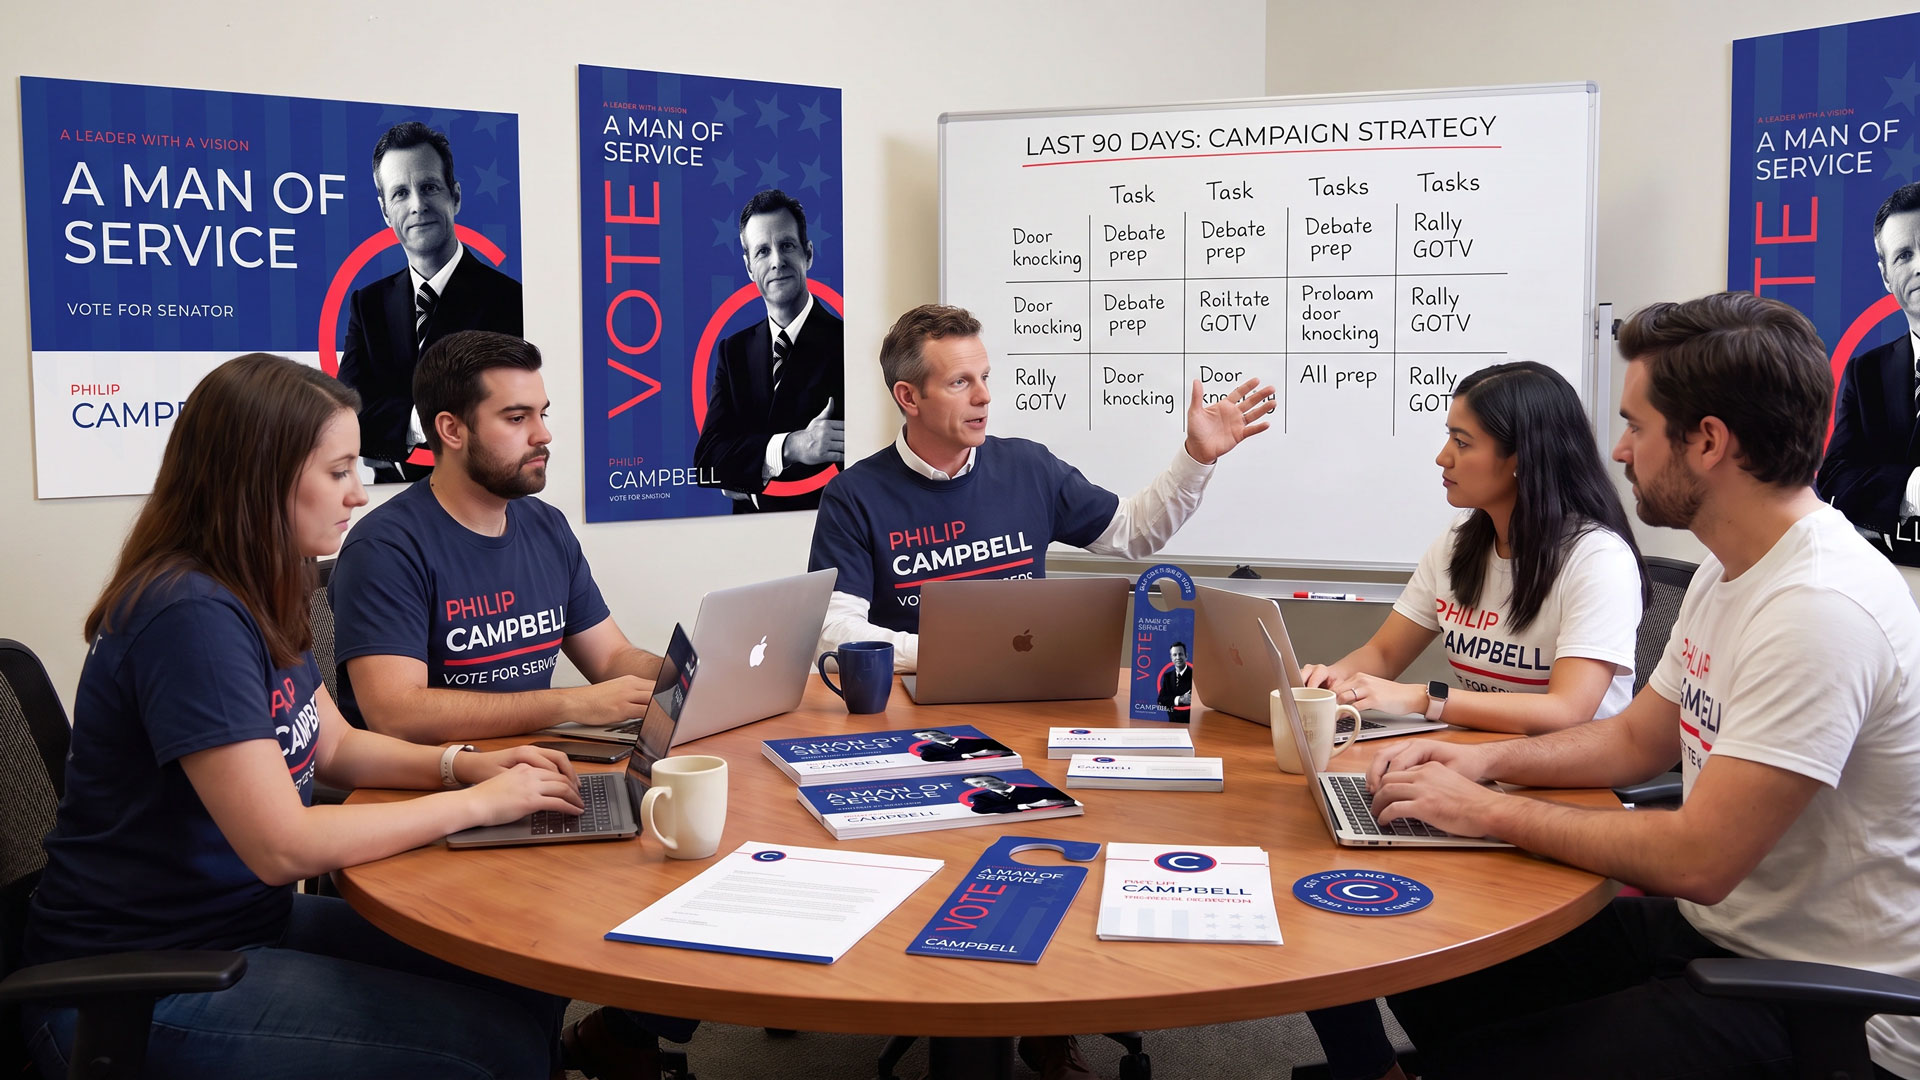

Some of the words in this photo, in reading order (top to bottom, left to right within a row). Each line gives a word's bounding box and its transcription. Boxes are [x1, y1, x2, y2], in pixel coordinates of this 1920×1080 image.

[610, 102, 637, 110] LEADER
[639, 104, 656, 112] WITH
[664, 106, 687, 114] VISION
[1765, 114, 1796, 123] LEADER
[1798, 112, 1818, 120] WITH
[1827, 108, 1855, 117] VISION
[603, 115, 620, 135] A
[628, 116, 683, 140] MAN
[691, 121, 723, 142] OF
[1028, 135, 1085, 155] LAST
[1093, 134, 1121, 152] 90
[1132, 130, 1200, 150] DAYS:
[1209, 123, 1348, 147] CAMPAIGN
[1359, 116, 1496, 141] STRATEGY
[1756, 131, 1775, 153] A
[1785, 124, 1849, 151] MAN
[1859, 119, 1900, 143] OF
[60, 129, 70, 141] A
[76, 130, 136, 144] LEADER
[141, 134, 180, 147] WITH
[185, 137, 195, 148] A
[200, 138, 249, 151] VISION
[604, 141, 703, 167] SERVICE
[1756, 151, 1873, 181] SERVICE
[62, 161, 104, 207] A
[123, 163, 253, 212] MAN
[273, 172, 346, 215] OF
[1206, 181, 1253, 200] Task
[1309, 176, 1368, 196] Tasks
[1417, 172, 1479, 192] Tasks
[1110, 185, 1155, 203] Task
[1104, 224, 1165, 241] Debate
[1202, 220, 1265, 238] Debate
[1306, 217, 1372, 235] Debate
[1415, 212, 1462, 238] Rally
[65, 220, 298, 269] SERVICE
[1013, 228, 1052, 244] Door
[1207, 247, 1245, 264] prep
[1311, 244, 1351, 261] prep
[1414, 239, 1473, 258] GOTV
[1754, 196, 1818, 298] TE
[1014, 249, 1081, 273] knocking
[1110, 250, 1147, 267] prep
[605, 180, 662, 419] VOTE
[1014, 297, 1052, 313] Door
[1104, 294, 1165, 310] Debate
[1413, 287, 1459, 312] Rally
[67, 303, 112, 317] VOTE
[118, 304, 153, 317] FOR
[158, 304, 234, 318] SENATOR
[1303, 305, 1340, 320] door
[1014, 319, 1081, 341] knocking
[1110, 320, 1146, 336] prep
[1201, 314, 1256, 331] GOTV
[1412, 314, 1470, 332] GOTV
[1303, 324, 1378, 348] knocking
[1016, 368, 1056, 392] Rally
[1104, 367, 1144, 384] Door
[1200, 366, 1242, 383] Door
[1300, 365, 1326, 383] All
[1336, 371, 1377, 389] prep
[1410, 366, 1457, 392] Rally
[71, 384, 120, 395] PHILIP
[1016, 394, 1066, 410] GOTV
[1104, 389, 1174, 413] knocking
[1409, 394, 1453, 412] GOT
[72, 402, 186, 428] CAMP
[609, 457, 644, 467] PHILIP
[609, 467, 721, 489] CAMPBELL
[889, 520, 966, 550] PHILIP
[893, 531, 1033, 576] CAMPBELL
[446, 590, 516, 622] PHILIP
[897, 594, 921, 606] VO
[1436, 598, 1499, 631] PHILIP
[446, 605, 566, 652] CAMPBELL
[1136, 632, 1153, 680] VOTE
[1440, 626, 1550, 671] AMPBELL
[443, 671, 488, 685] VOTE
[492, 666, 519, 682] FOR
[522, 654, 559, 676] SERVIC
[275, 693, 320, 757] CAMPB
[794, 743, 893, 756] SERVICE
[810, 739, 866, 749] MAN
[829, 790, 942, 806] SERVICE
[850, 786, 911, 798] MAN
[760, 852, 779, 860] C
[1168, 855, 1200, 869] C
[976, 874, 1045, 885] SERVICE
[993, 868, 1035, 878] MAN
[1039, 872, 1065, 880] OF
[1320, 872, 1348, 880] OUT
[1122, 885, 1253, 896] CAMPBELL
[1342, 884, 1381, 899] C
[936, 883, 1008, 931] VOTE
[925, 938, 1018, 953] CAMPBELL
